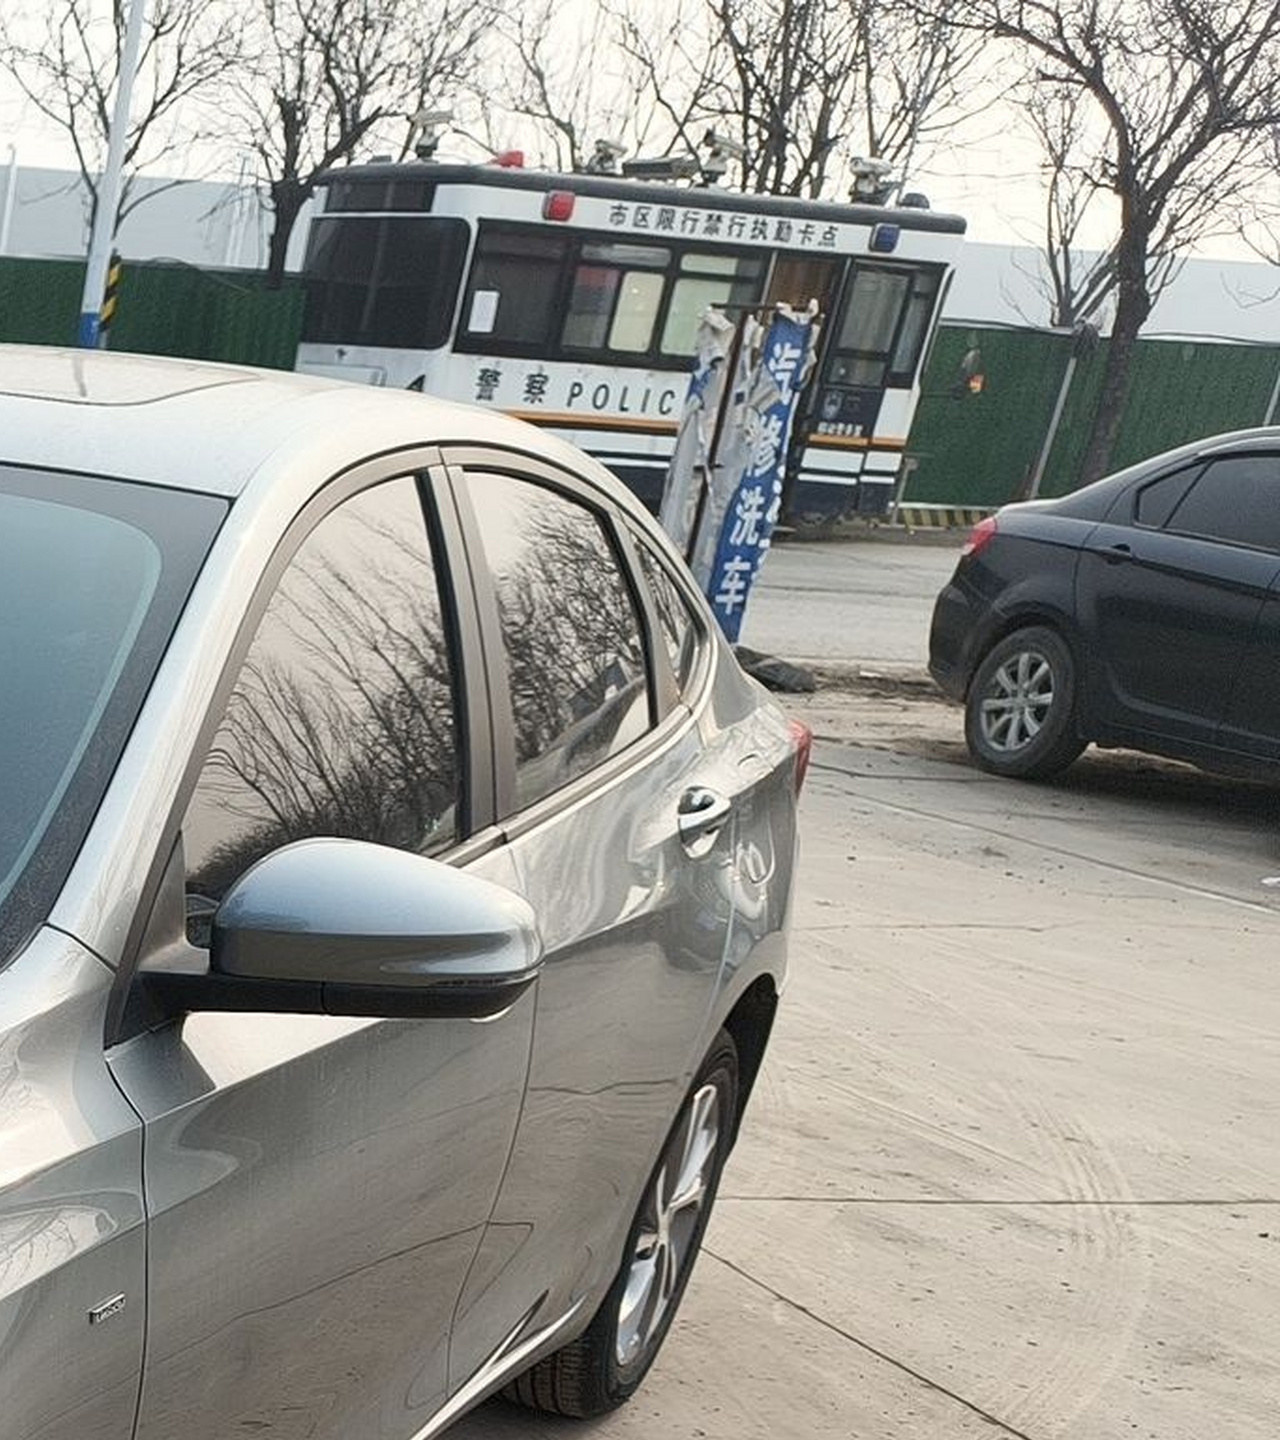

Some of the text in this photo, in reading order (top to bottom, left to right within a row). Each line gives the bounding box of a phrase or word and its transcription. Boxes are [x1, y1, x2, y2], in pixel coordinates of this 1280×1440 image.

[609, 202, 840, 248] 市区限行禁行执勤卡点
[475, 367, 676, 415] 警察 POLIC
